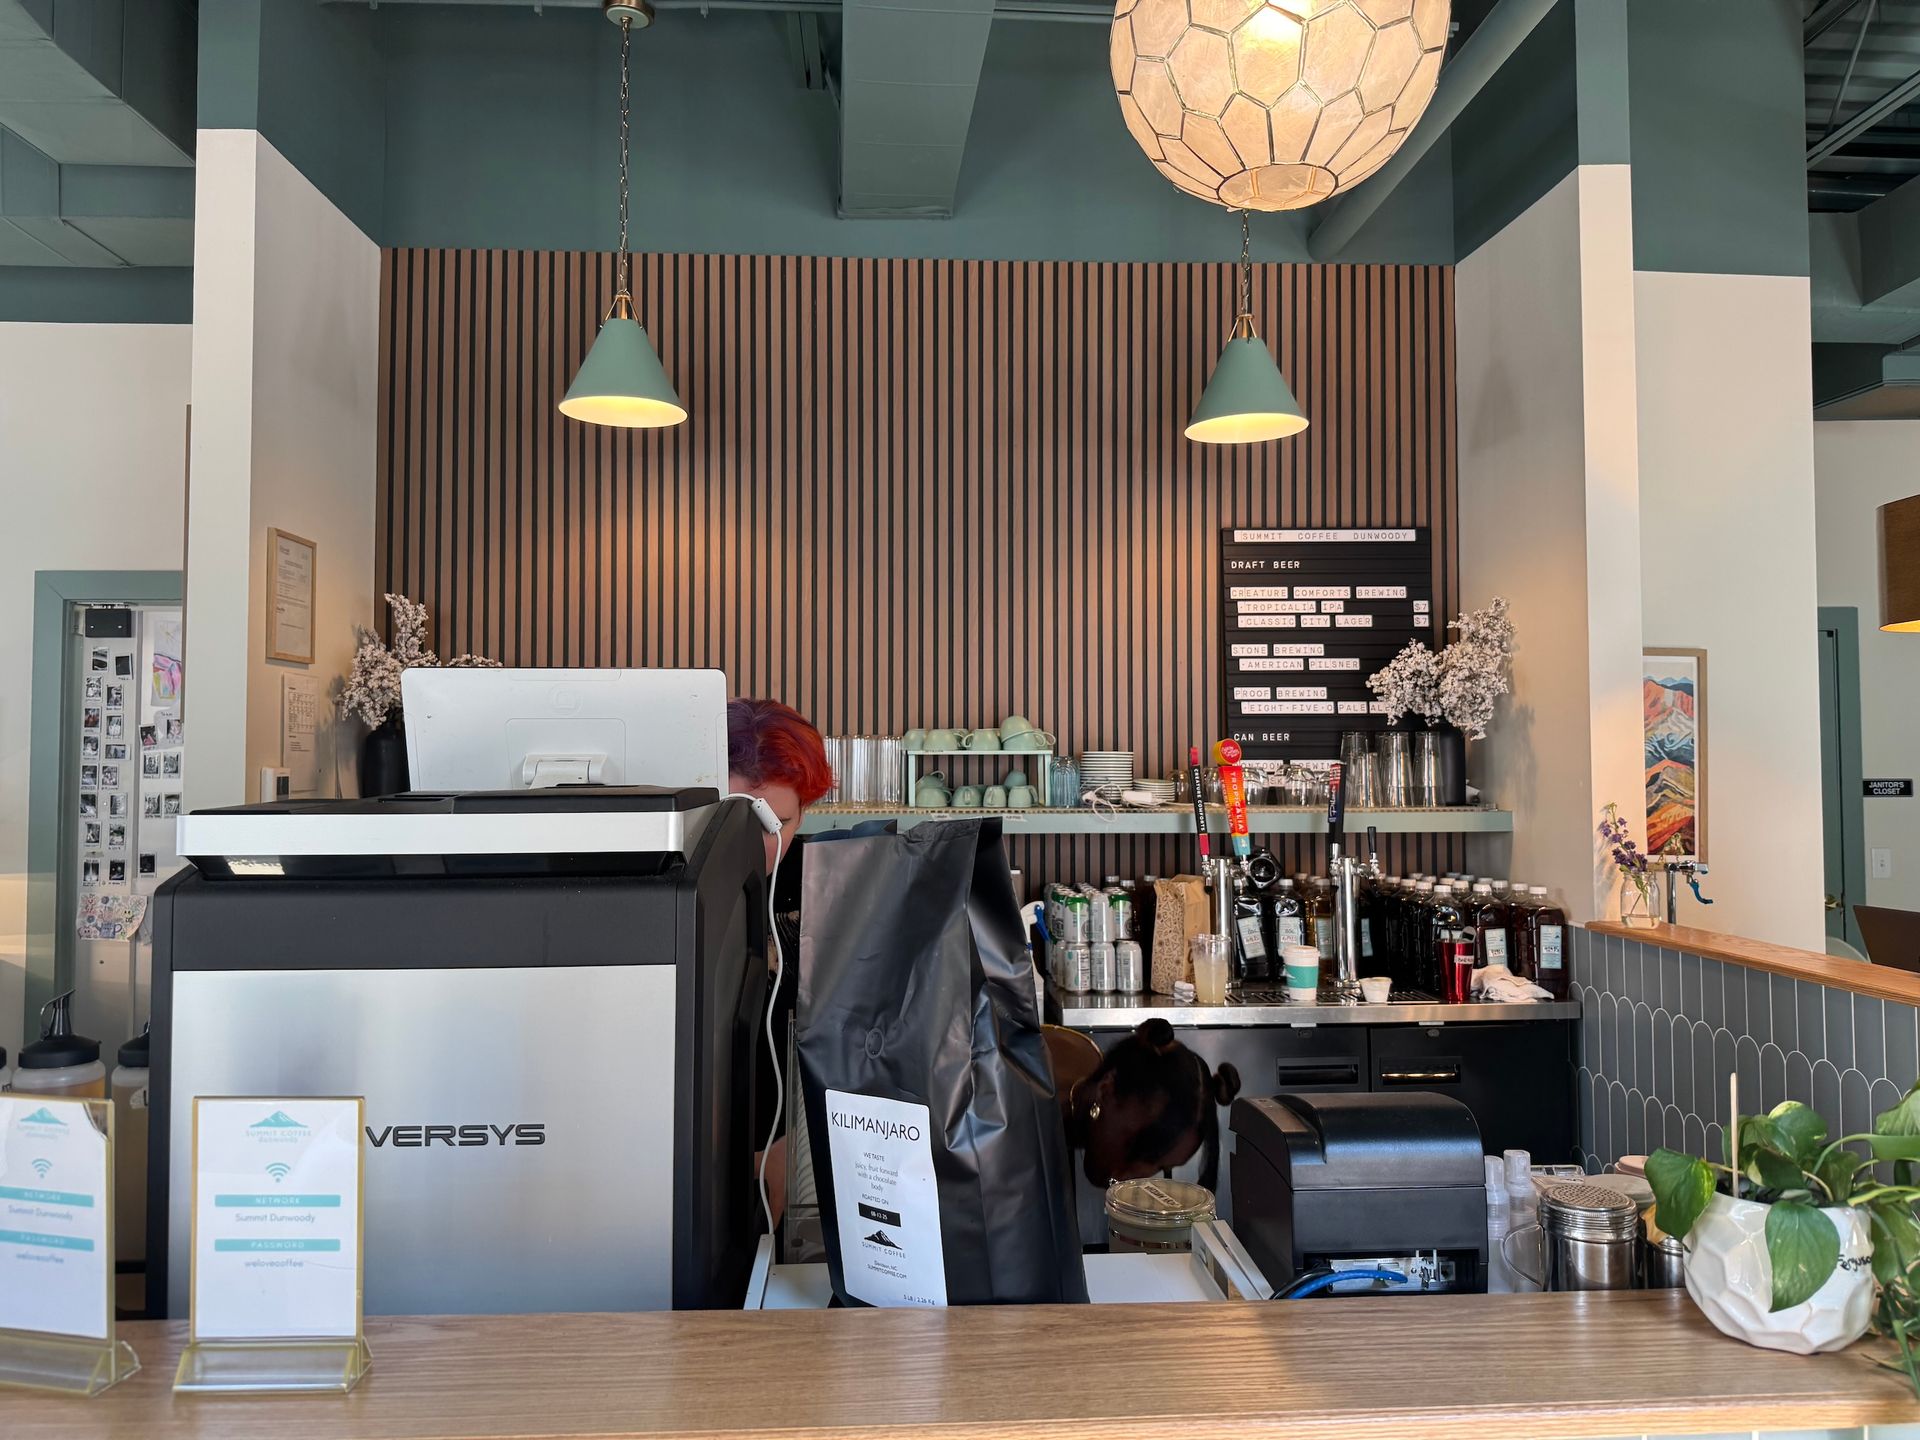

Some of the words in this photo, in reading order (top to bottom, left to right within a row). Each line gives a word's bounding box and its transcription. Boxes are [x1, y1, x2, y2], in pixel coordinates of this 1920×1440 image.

[1241, 532, 1284, 541] SUMMIT
[1297, 532, 1339, 541] COFFEE
[1353, 532, 1408, 541] DUNWOODY
[1230, 560, 1266, 570] DRAFT
[1273, 560, 1301, 570] BEER
[1230, 589, 1288, 598] CREATURE
[1293, 588, 1350, 598] COMFORTS
[1356, 588, 1406, 598] BREWING
[1322, 602, 1344, 612] IPA
[1301, 616, 1330, 626] CITY
[1336, 616, 1371, 626] LAGER
[1232, 646, 1268, 655] STONE
[1274, 646, 1323, 655] BREWING
[1309, 660, 1359, 669] PILSNER
[1234, 689, 1270, 698] PROOF
[1277, 689, 1327, 698] BREWING
[1338, 703, 1366, 712] PALE
[1233, 732, 1254, 742] CAN
[1262, 732, 1291, 742] BEER
[1193, 768, 1202, 799] CREATURE
[1230, 771, 1244, 830] TROPICALIA
[1197, 799, 1206, 832] COMFORTS
[831, 1112, 920, 1141] KILIMANJARO
[365, 1124, 546, 1147] VERSYS
[872, 1153, 885, 1161] TASTE
[872, 1174, 897, 1185] chocolate
[870, 1182, 883, 1192] body
[235, 1212, 268, 1222] Summit
[269, 1211, 316, 1224] Dunwoody
[861, 1241, 882, 1252] SUMMIT
[884, 1248, 906, 1258] COFFEE
